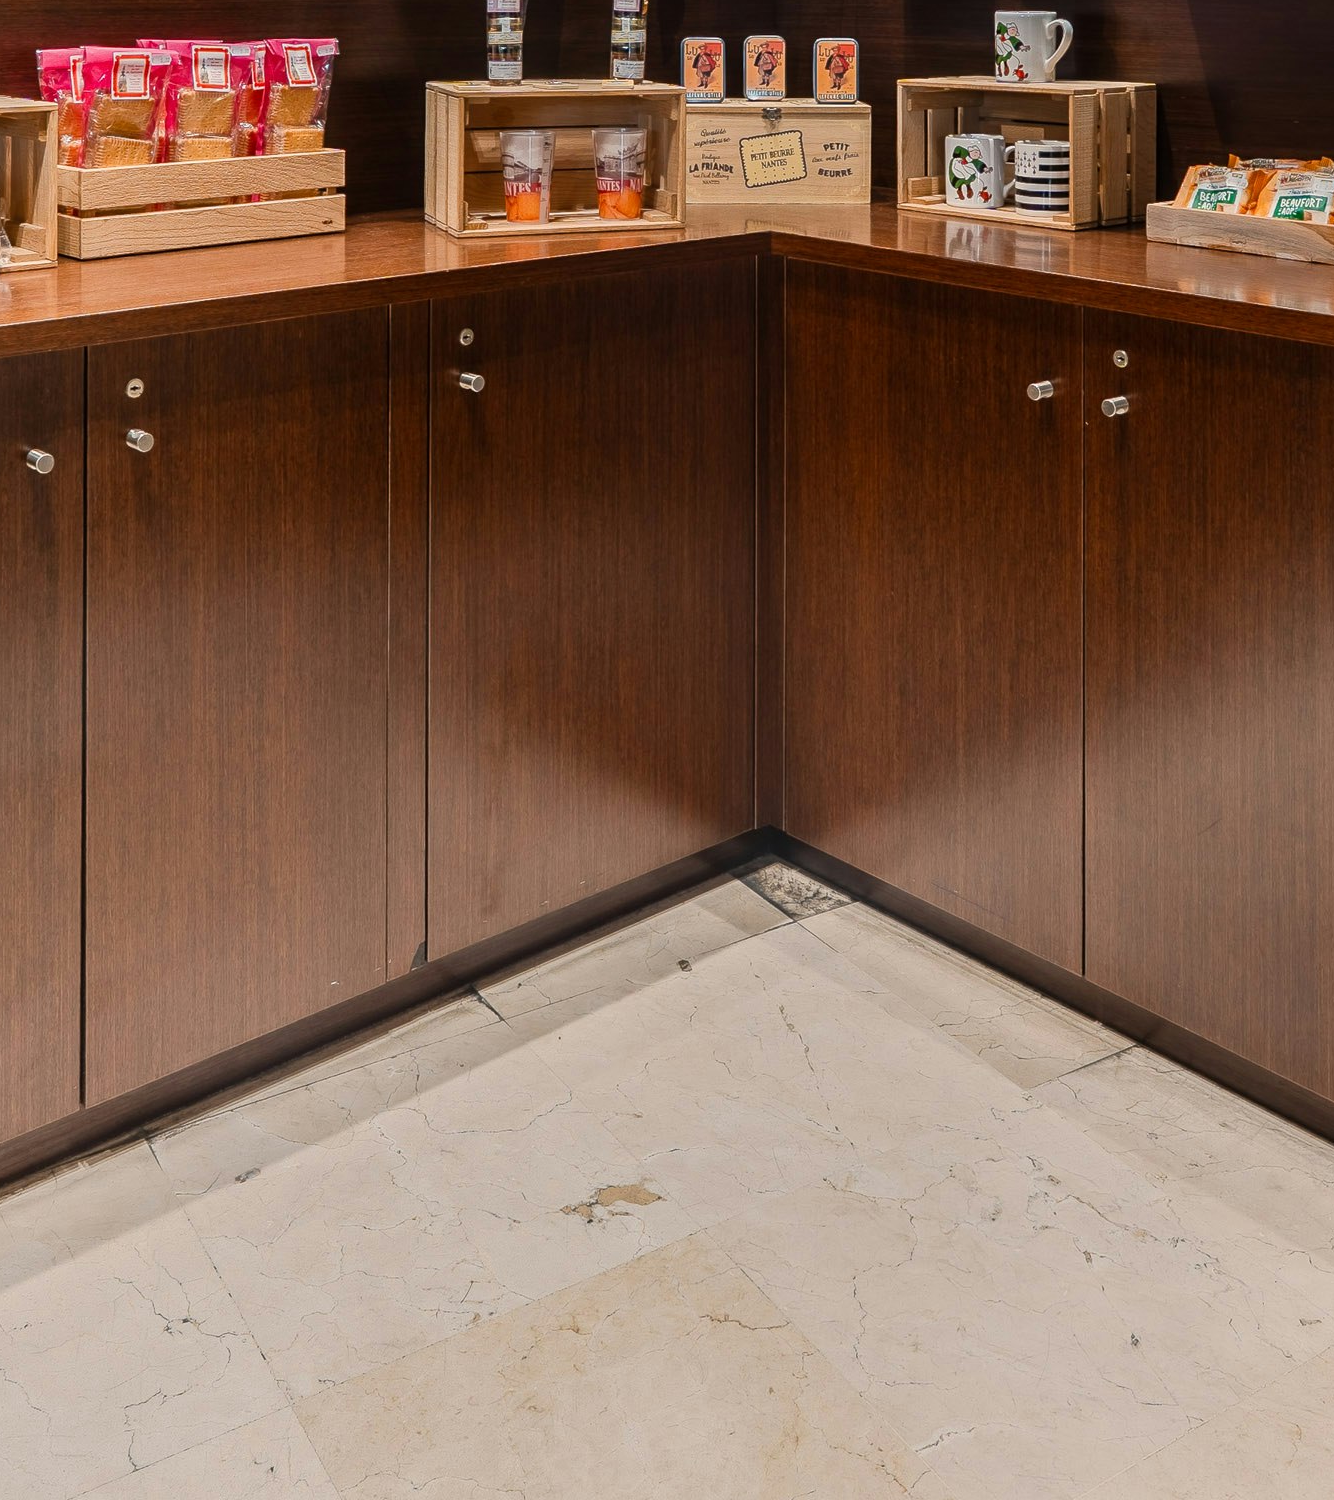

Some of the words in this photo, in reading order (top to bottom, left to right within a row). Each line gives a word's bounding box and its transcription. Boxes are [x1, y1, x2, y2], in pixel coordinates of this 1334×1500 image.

[823, 143, 850, 152] PETIT
[751, 152, 767, 161] PETIT
[769, 148, 795, 159] BEURRE
[689, 164, 699, 173] LA
[701, 162, 734, 174] FRIANDE
[761, 158, 788, 169] NANTES
[818, 167, 853, 178] BEURRE
[1280, 197, 1321, 208] BEAUFORT
